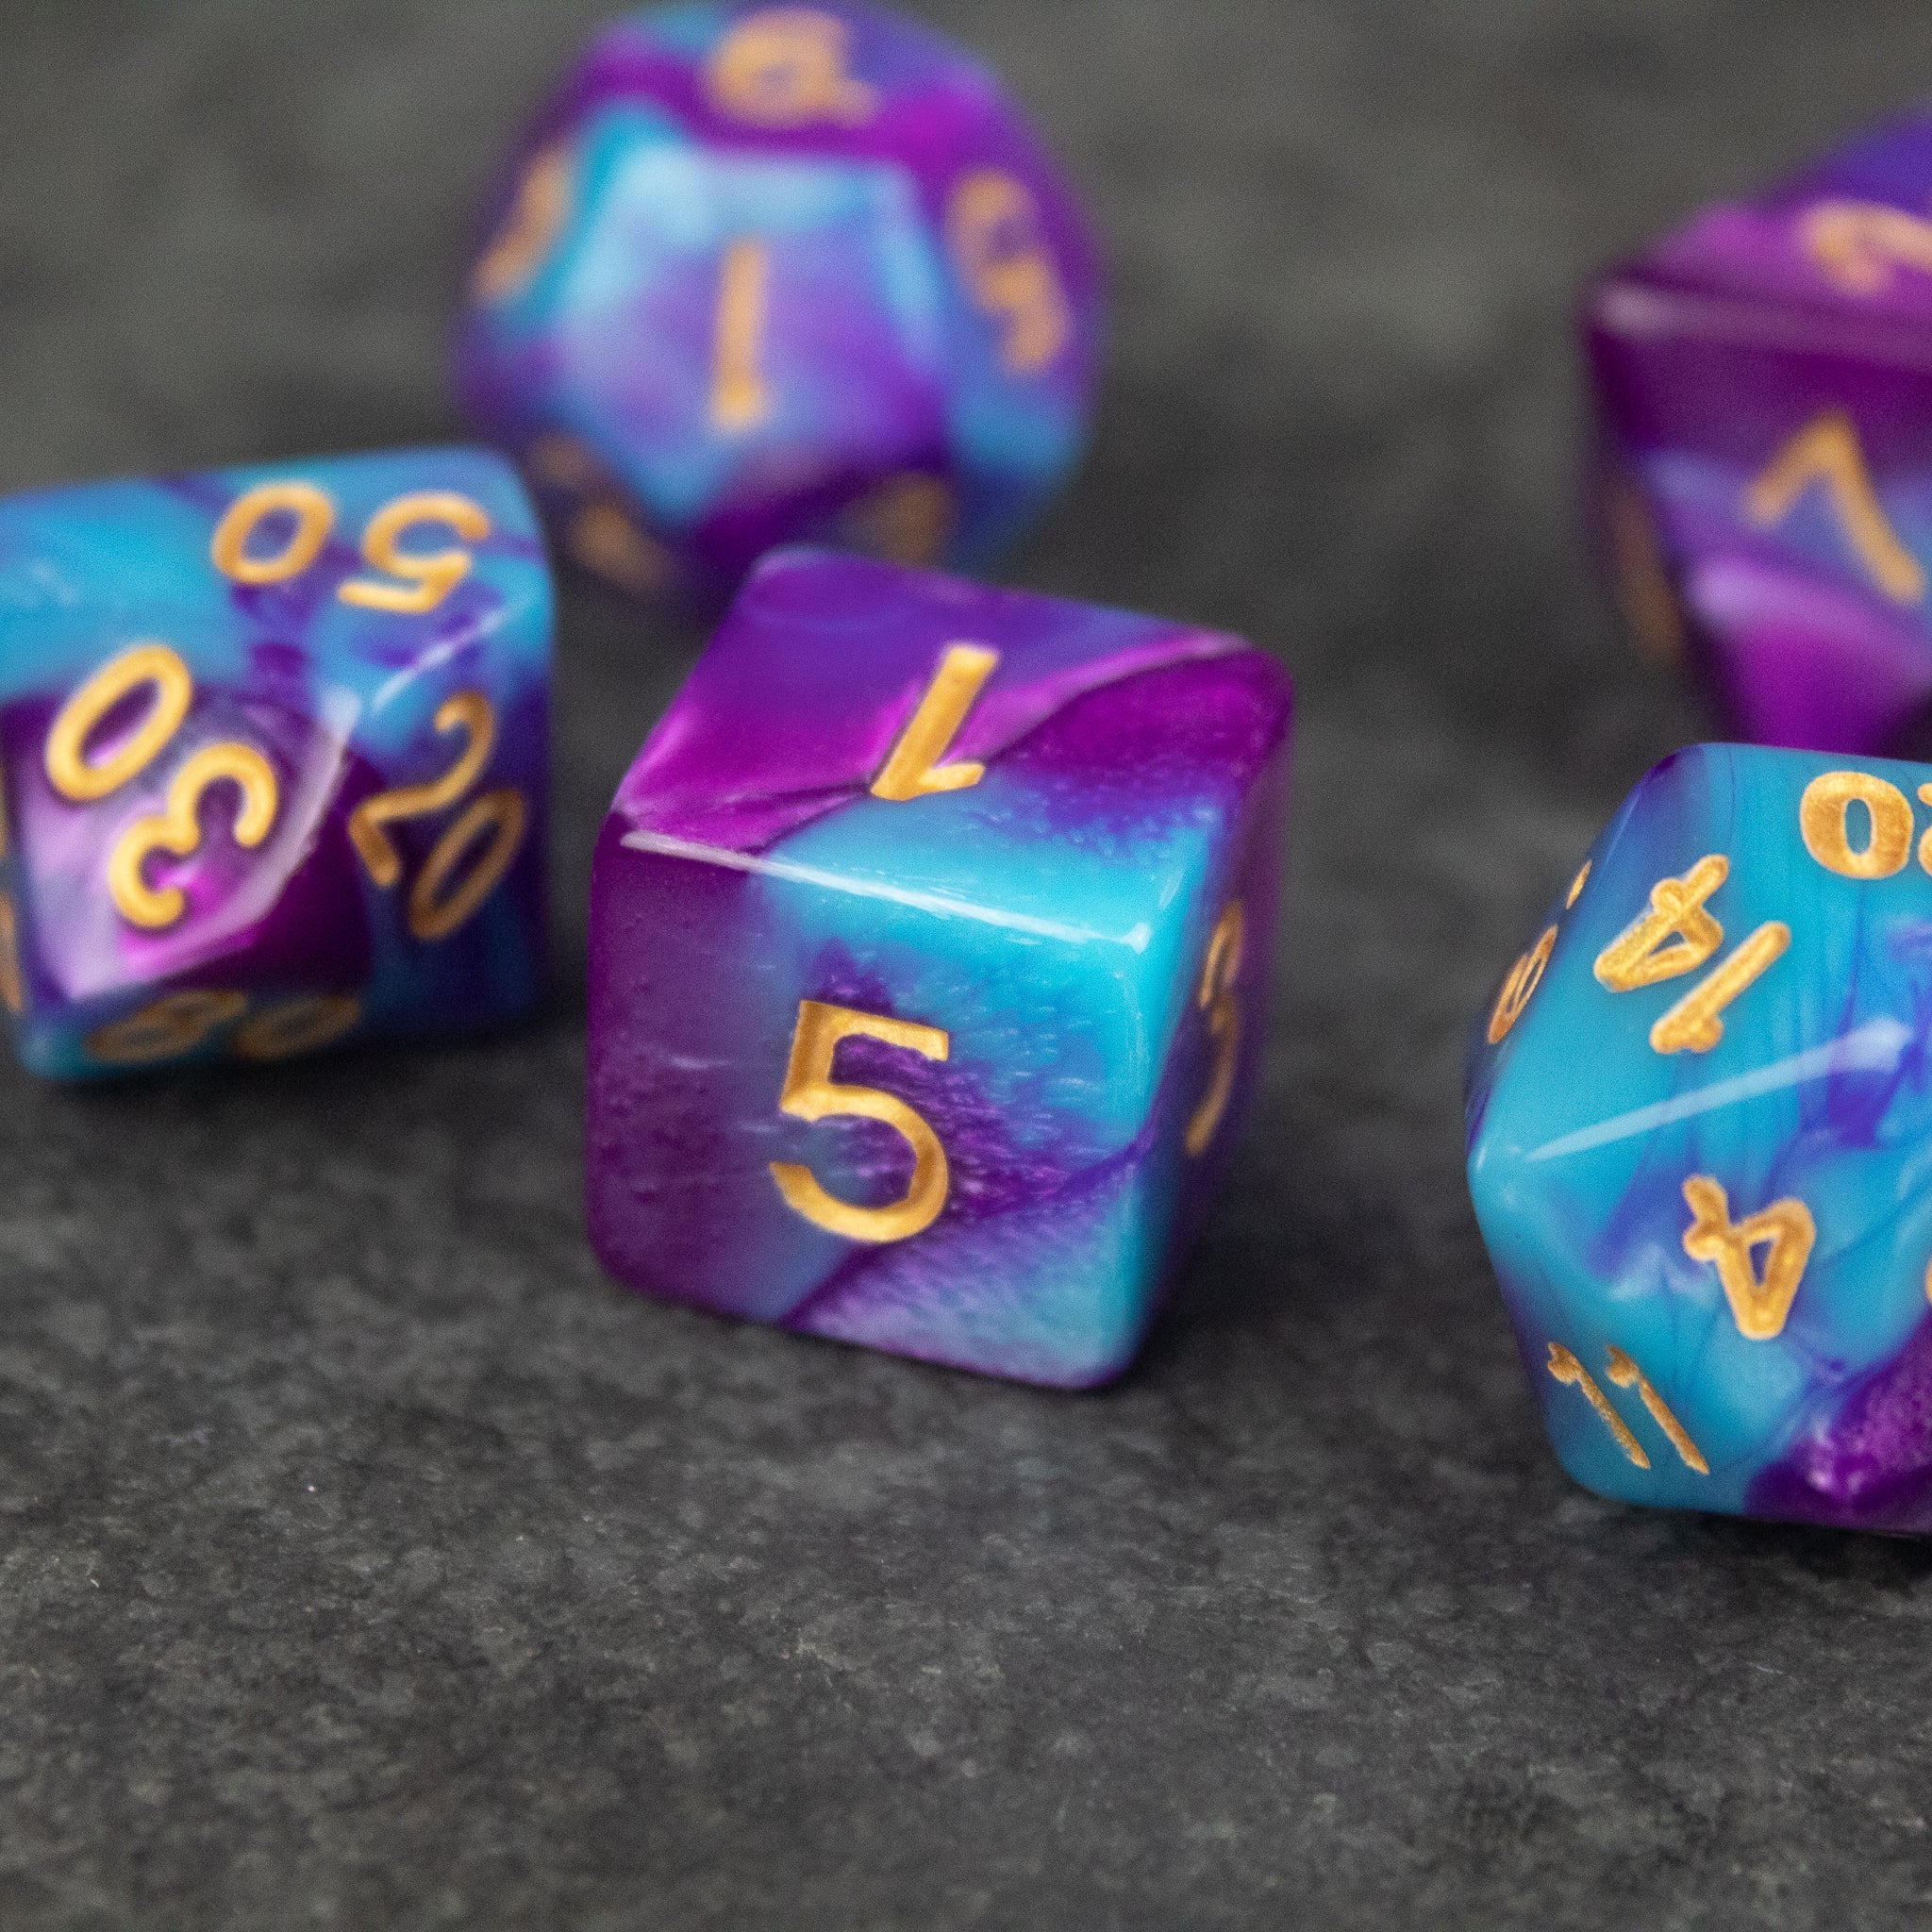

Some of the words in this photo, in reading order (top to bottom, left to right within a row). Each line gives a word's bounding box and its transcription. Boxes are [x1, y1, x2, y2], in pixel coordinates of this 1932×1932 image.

[712, 234, 766, 430] 1
[211, 483, 491, 614] 50
[46, 645, 279, 929] 30
[871, 647, 998, 801] 1
[346, 691, 526, 941] 20
[1800, 771, 1932, 878] 0
[1594, 855, 1790, 1055] 14
[770, 1000, 950, 1242] 5
[1683, 1175, 1816, 1340] 4
[1548, 1341, 1709, 1474] 11
